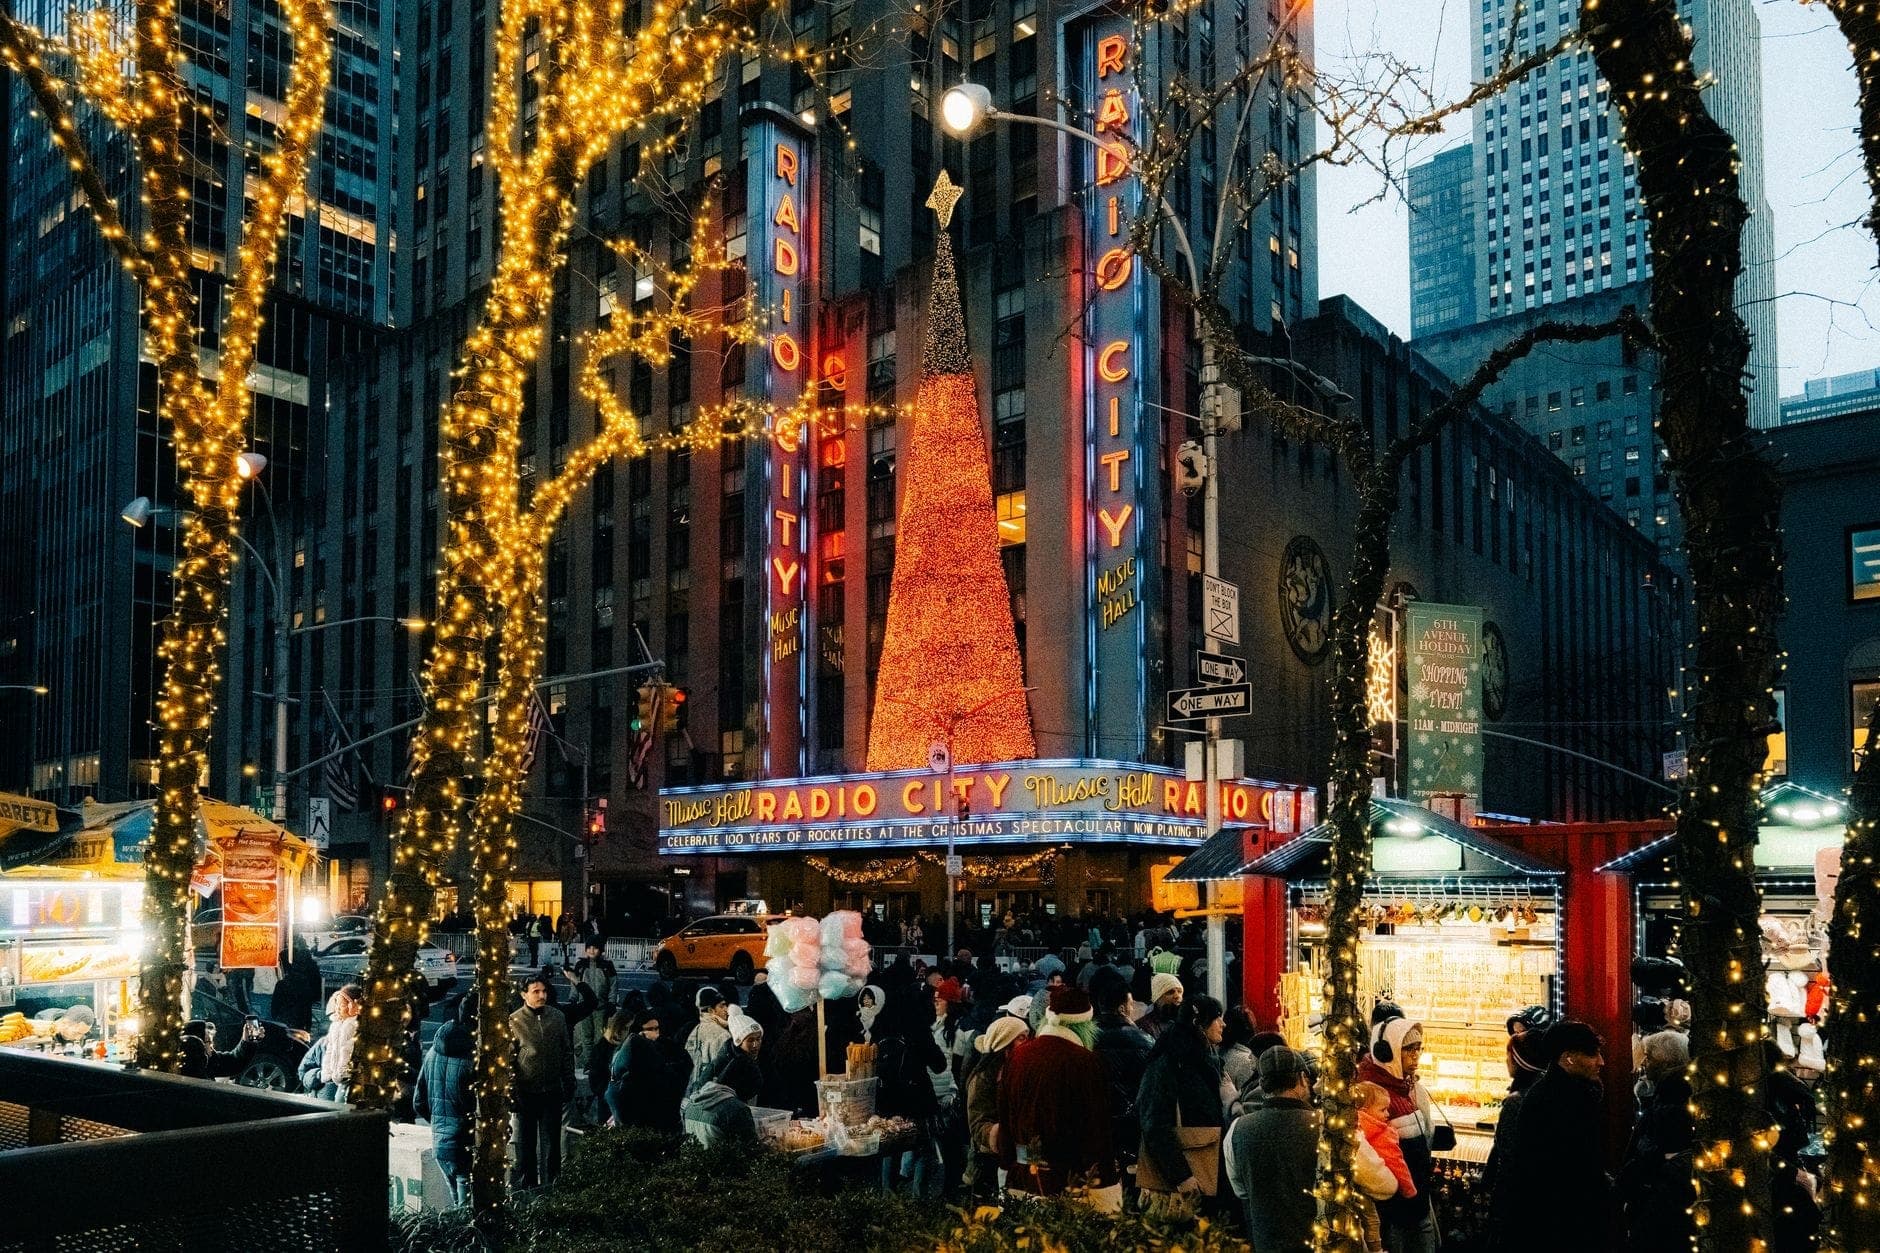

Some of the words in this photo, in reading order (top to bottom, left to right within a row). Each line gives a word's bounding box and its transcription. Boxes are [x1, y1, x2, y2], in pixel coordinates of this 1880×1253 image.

[1097, 34, 1132, 290] RADIO
[773, 143, 800, 371] RADIO
[1099, 340, 1133, 547] CITY
[773, 416, 799, 595] CITY
[1098, 556, 1136, 602] MUSIC
[1103, 590, 1136, 630] HALL
[1212, 595, 1221, 607] THE
[1222, 598, 1231, 610] BOX
[771, 607, 798, 637] MUSIC
[1434, 620, 1457, 630] 6TH
[1420, 640, 1472, 654] HOLIDAY
[1423, 630, 1468, 643] AVENUE
[774, 637, 798, 664] HALL
[1204, 662, 1218, 675] ONE
[1224, 664, 1239, 679] WAY
[1421, 663, 1467, 689] SHOPPING
[1180, 697, 1203, 711] ONE
[1214, 694, 1240, 707] WAY
[1429, 689, 1463, 710] EVENT!
[1414, 719, 1434, 731] 11AM
[1440, 720, 1479, 734] MIDNIGHT
[665, 798, 712, 827] Music
[709, 789, 753, 827] Hall
[757, 783, 877, 820] RADIO
[902, 774, 1012, 813] CITY
[1024, 774, 1110, 807] Music
[1104, 772, 1154, 811] Hall
[1163, 779, 1248, 818] RAIO
[667, 833, 719, 848] CELEBRATE
[725, 832, 744, 845] 100
[750, 831, 781, 844] YEARS
[787, 831, 801, 842] OF
[808, 827, 876, 841] ROCKETTES
[879, 826, 894, 838] AT
[902, 825, 923, 838] THE
[931, 822, 1002, 837] CHISTMAS
[1134, 822, 1153, 835] NOW
[1157, 823, 1191, 838] PLAYING
[1196, 826, 1207, 838] TH
